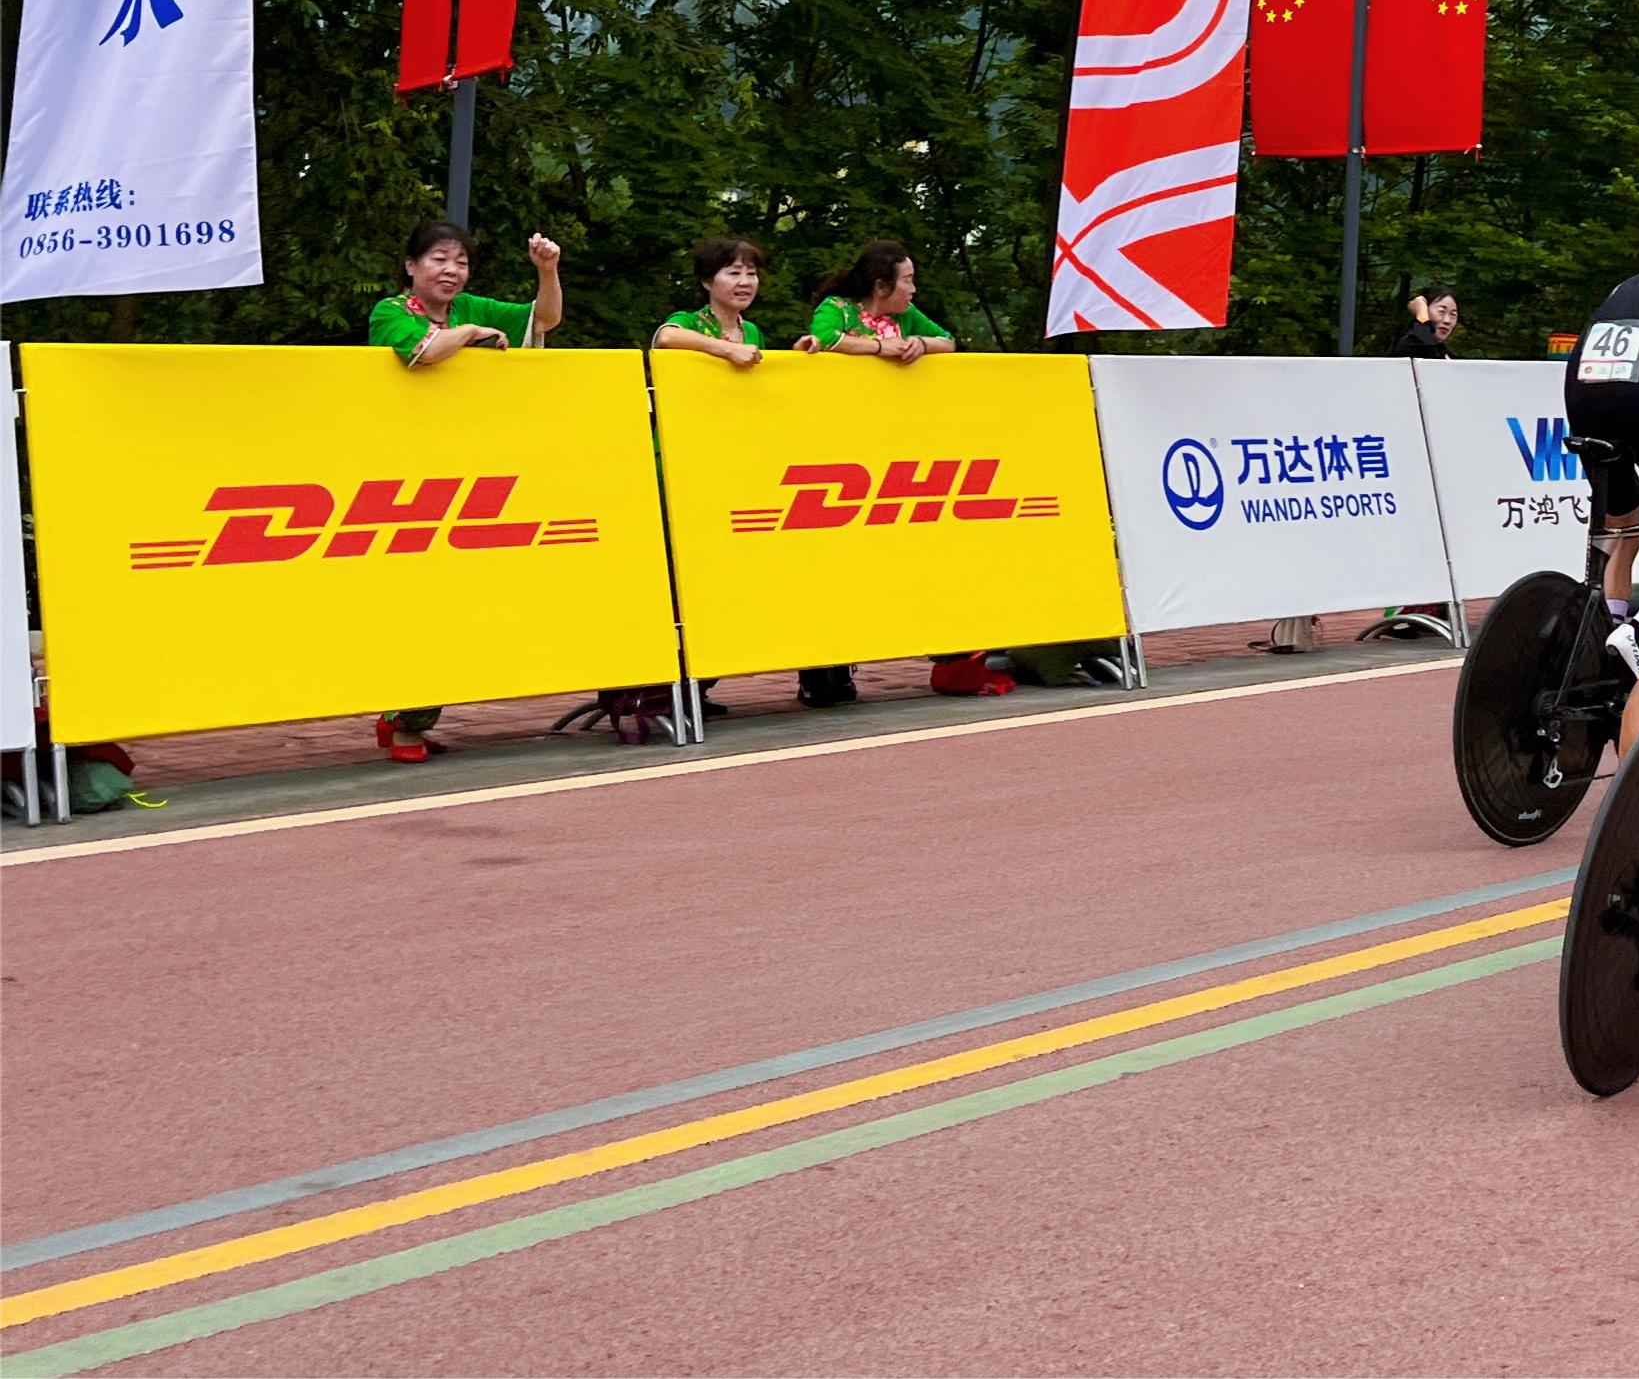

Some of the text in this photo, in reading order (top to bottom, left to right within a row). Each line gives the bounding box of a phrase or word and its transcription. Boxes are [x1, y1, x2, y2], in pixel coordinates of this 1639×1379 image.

[19, 218, 236, 260] 0856-3901698
[1592, 326, 1633, 357] 46
[1231, 434, 1391, 486] 万达体育
[779, 458, 1020, 531] DHL
[1241, 490, 1398, 524] WANDA SPORTS
[1497, 494, 1593, 530] 万鸿飞
[203, 475, 543, 566] DHL
